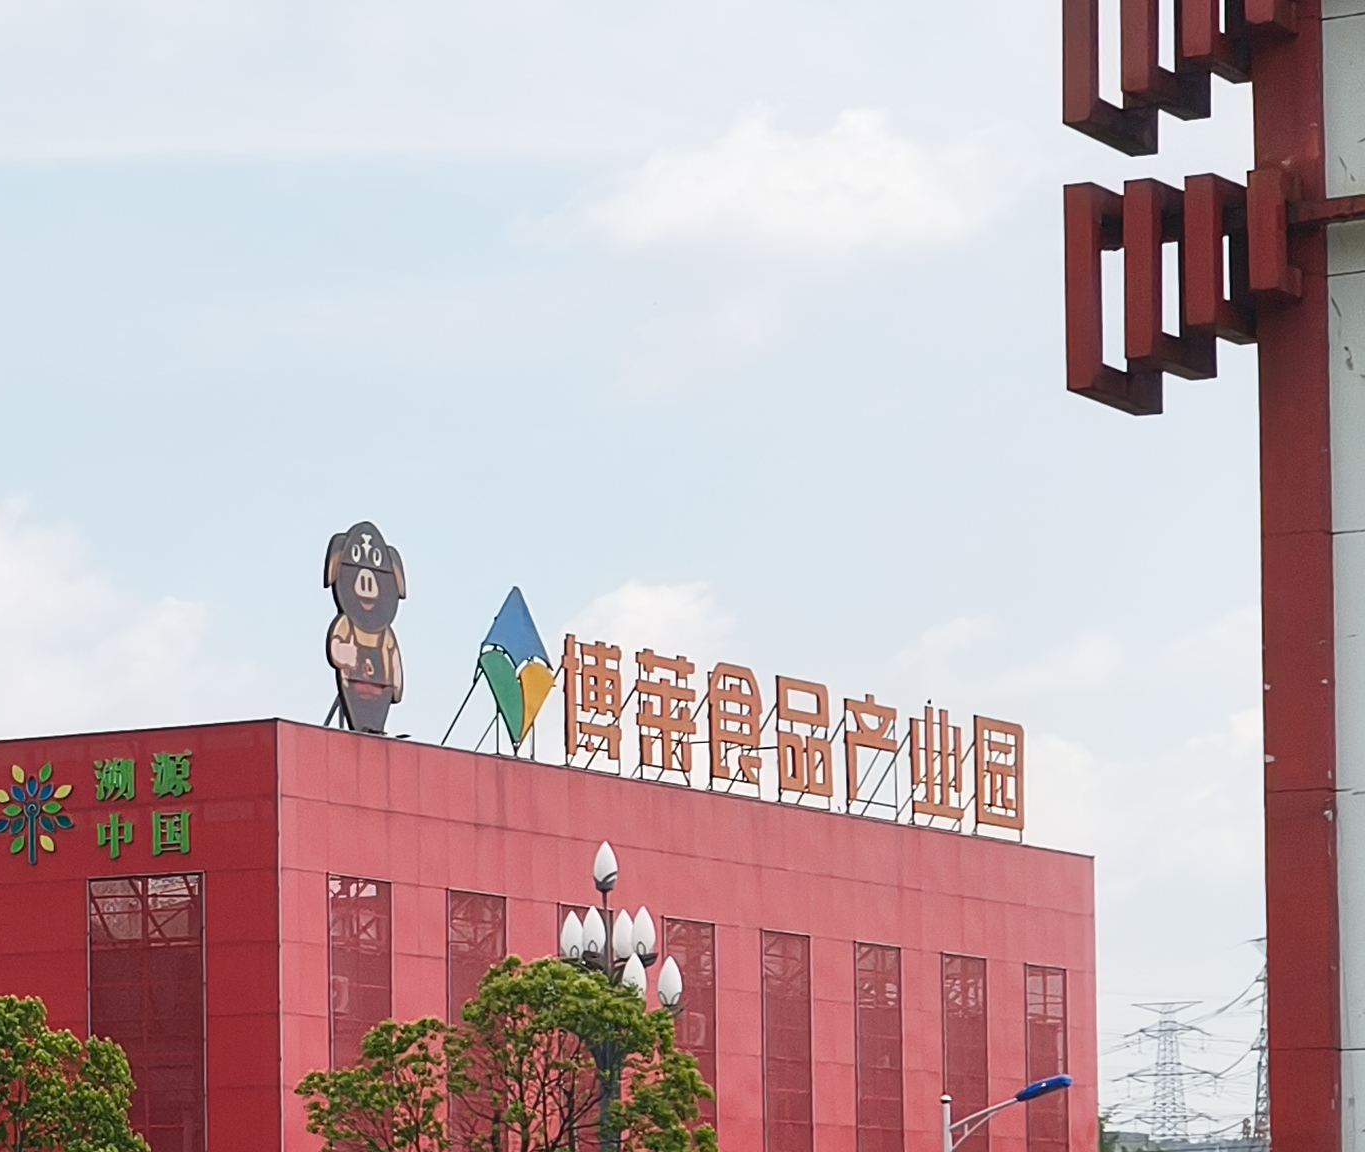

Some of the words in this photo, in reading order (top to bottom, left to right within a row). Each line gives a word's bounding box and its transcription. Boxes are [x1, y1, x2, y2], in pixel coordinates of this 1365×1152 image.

[562, 633, 1025, 830] 博莱食品产业园
[94, 749, 192, 801] 溯源
[96, 809, 191, 859] 中国
